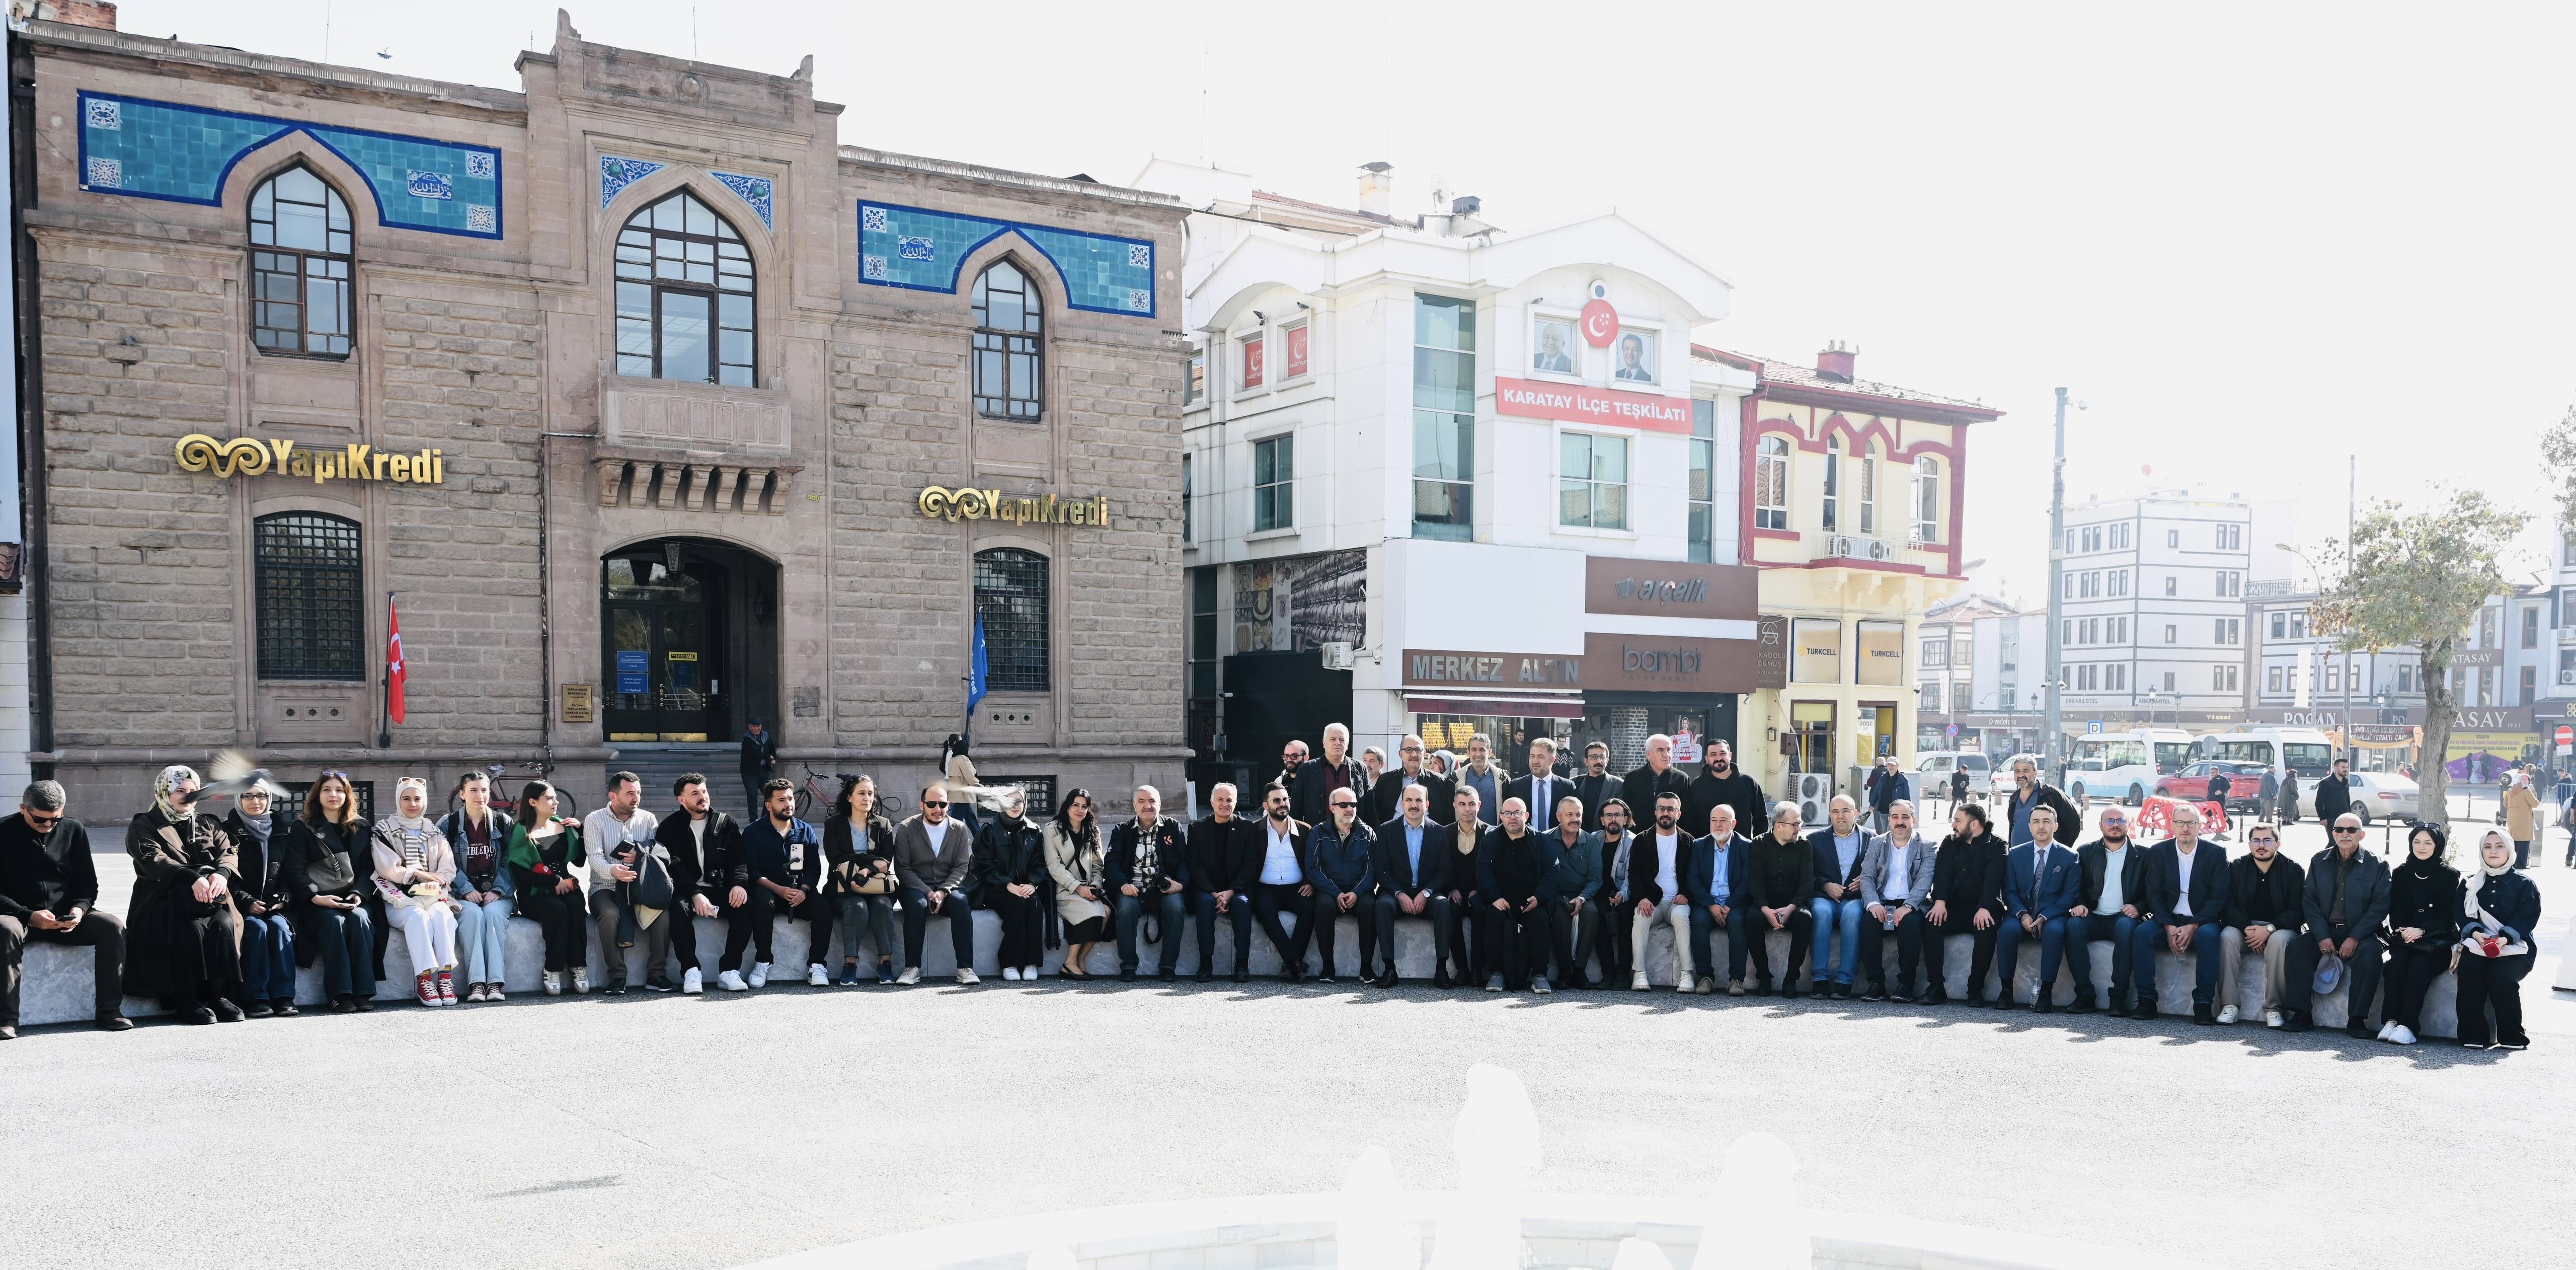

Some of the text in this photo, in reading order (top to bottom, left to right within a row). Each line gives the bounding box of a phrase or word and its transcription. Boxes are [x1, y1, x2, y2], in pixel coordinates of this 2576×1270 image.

[1504, 389, 1686, 421] KARATAY İLÇE TEŞKİLATI
[269, 439, 442, 484] YapıKredi
[983, 489, 1108, 527] YapıKredi
[1637, 578, 1709, 606] arçelik
[1413, 655, 1579, 684] MERKEZ ALTIN
[1622, 644, 1701, 672] bambi
[1757, 660, 1782, 668] GÜMÜŞ
[2450, 653, 2491, 663] ATASAY
[2091, 724, 2098, 732] D
[2452, 711, 2508, 728] ASAY
